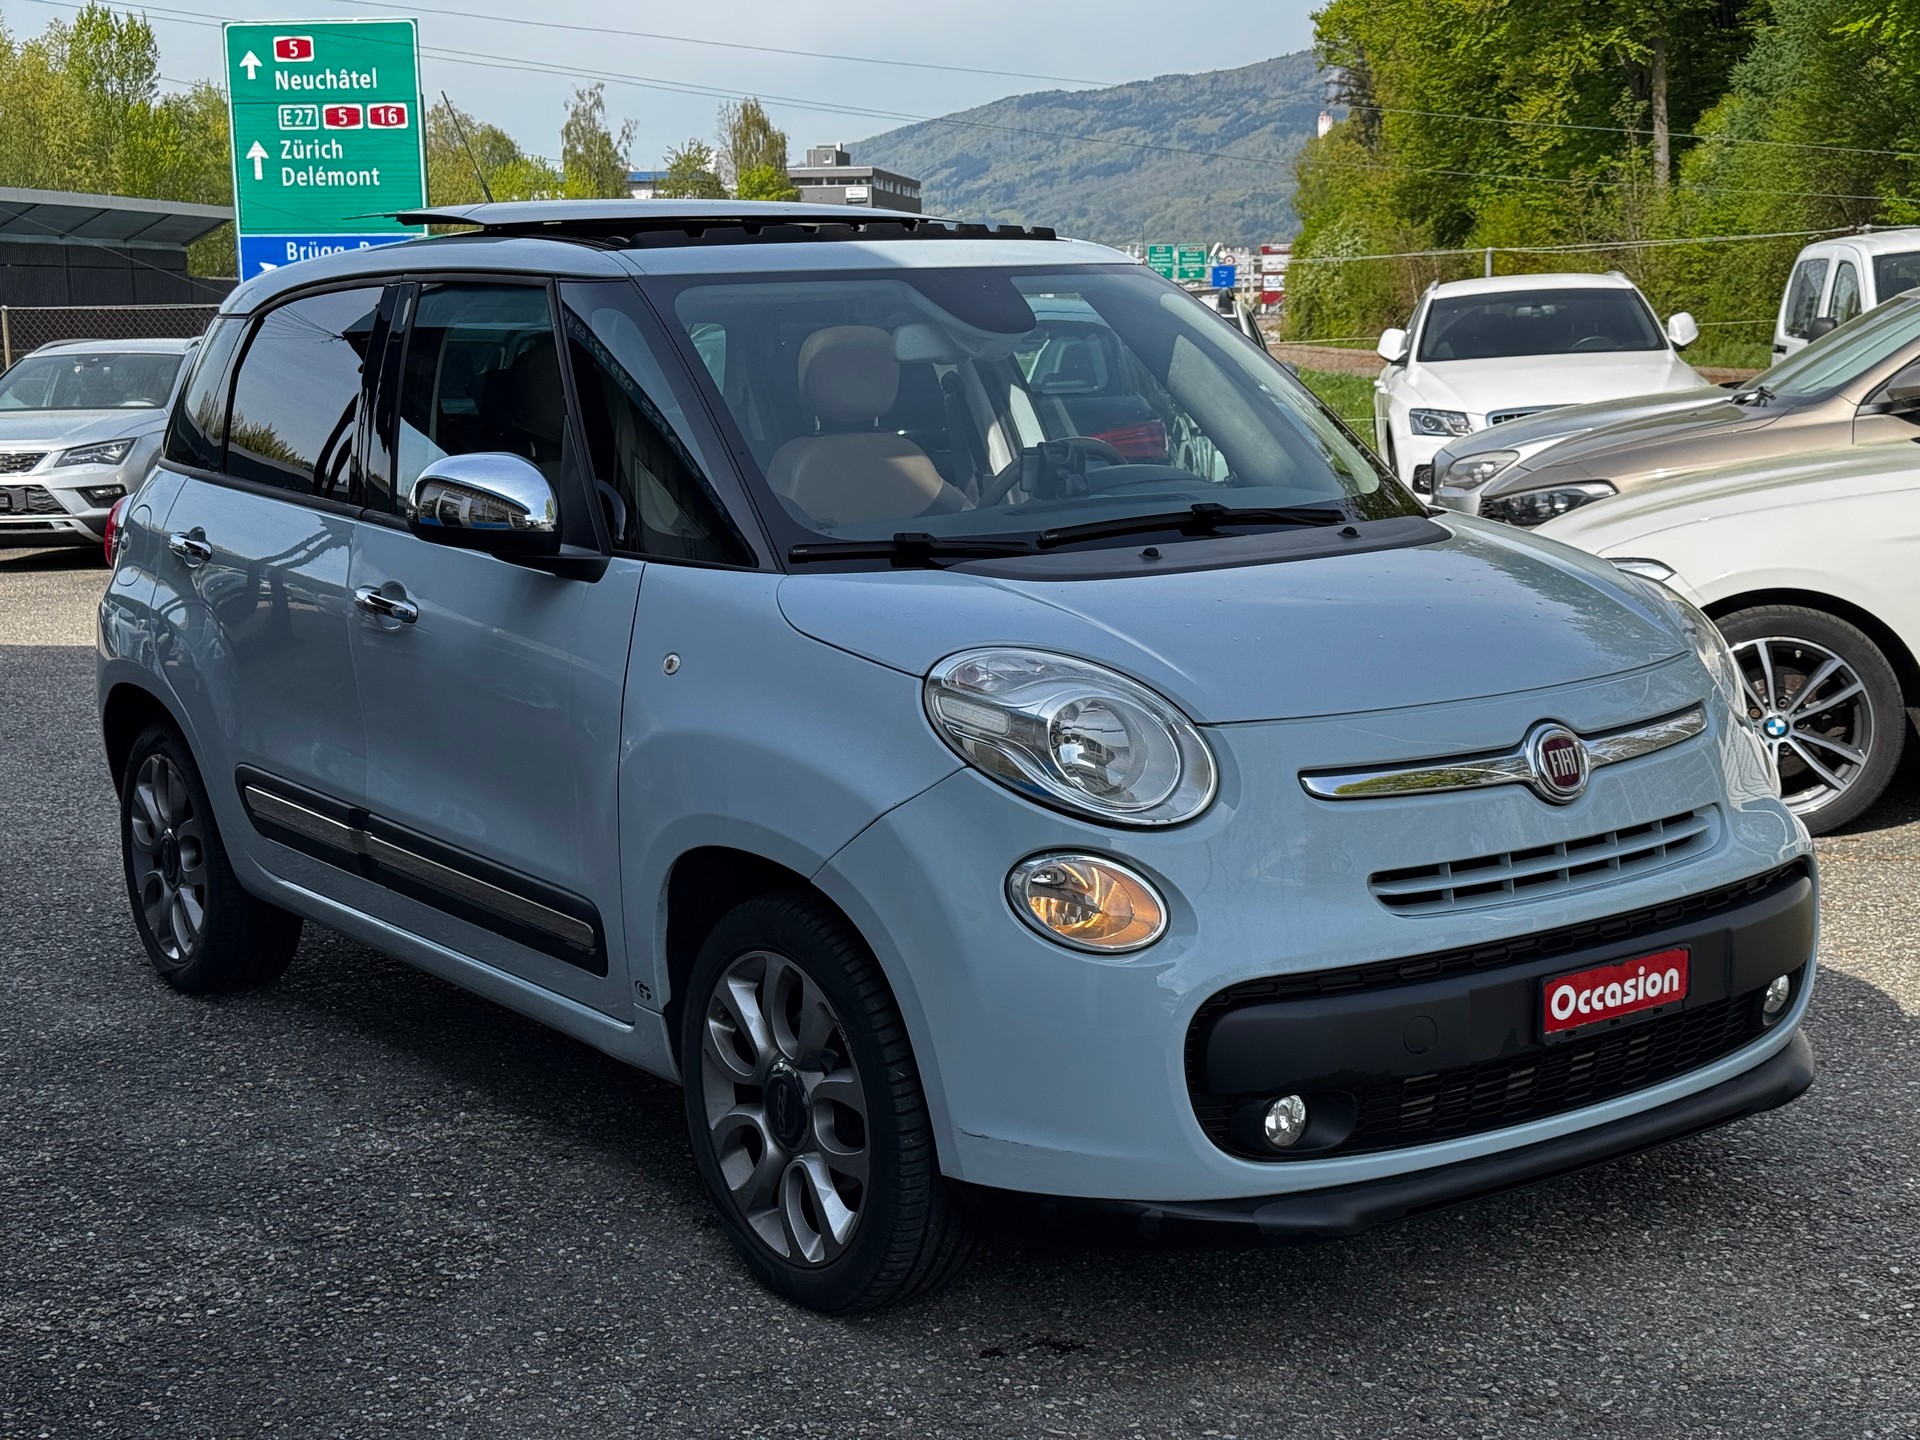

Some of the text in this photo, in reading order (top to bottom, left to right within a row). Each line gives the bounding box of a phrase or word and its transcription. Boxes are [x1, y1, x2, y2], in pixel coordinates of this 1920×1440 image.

[289, 41, 299, 57] 5
[275, 67, 377, 90] Neuchâtel
[338, 109, 348, 125] 5
[378, 108, 398, 124] 16
[280, 139, 343, 160] Zürich
[282, 166, 380, 187] Delémont
[1548, 747, 1578, 777] FIAT
[1551, 966, 1679, 1020] Occasion
